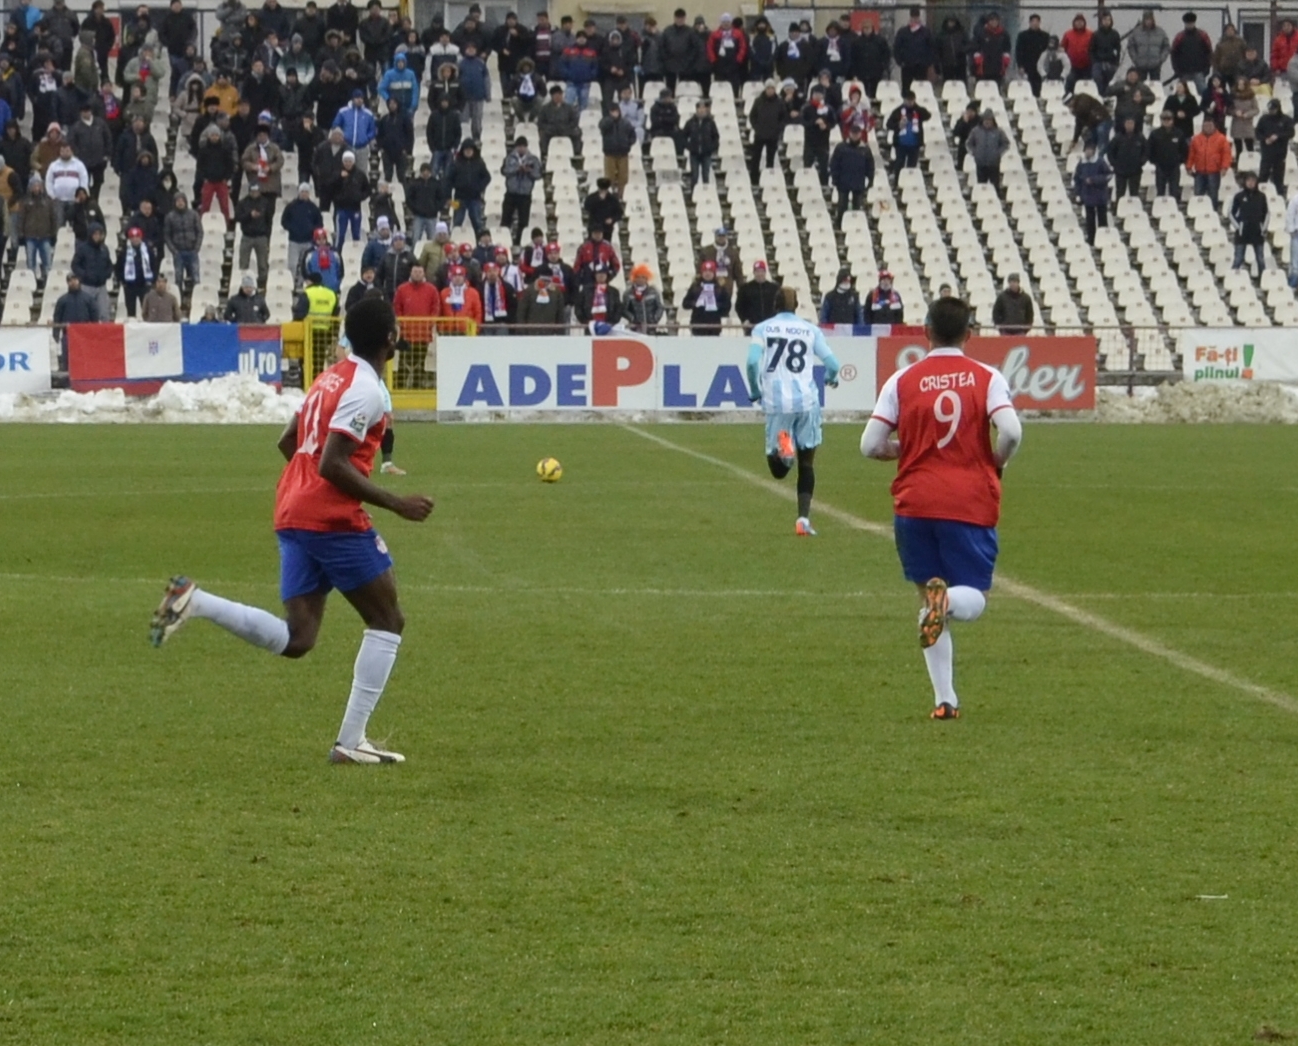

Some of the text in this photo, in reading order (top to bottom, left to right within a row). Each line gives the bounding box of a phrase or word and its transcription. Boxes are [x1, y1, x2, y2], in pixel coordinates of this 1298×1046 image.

[455, 339, 828, 408] ADEPLA
[766, 336, 808, 374] 78
[919, 371, 976, 392] CRISTEA
[933, 390, 963, 449] 9
